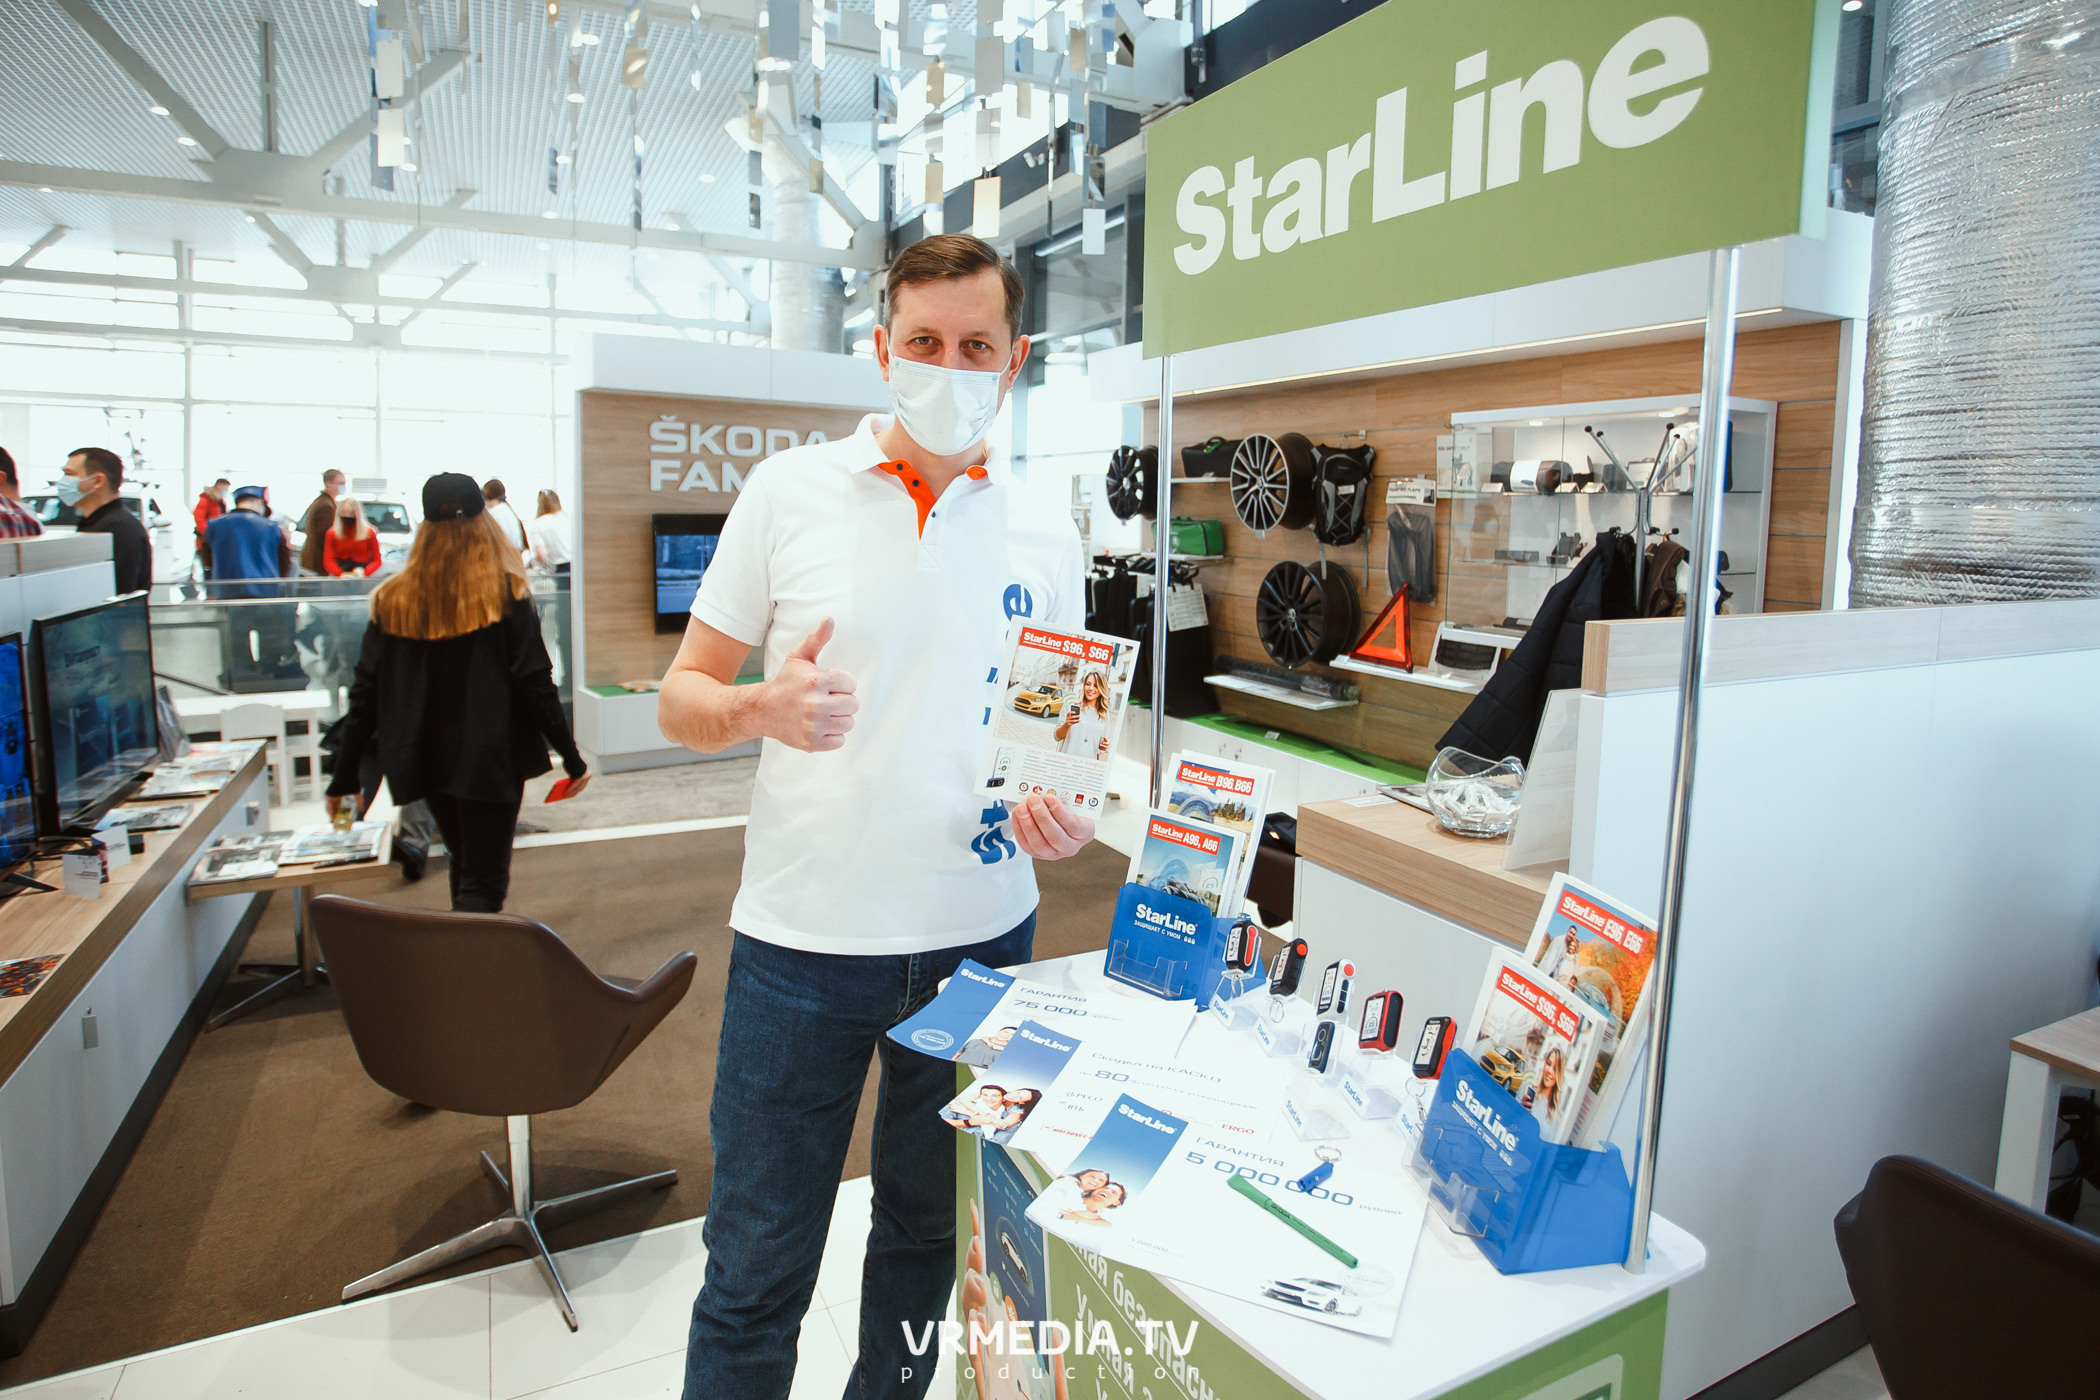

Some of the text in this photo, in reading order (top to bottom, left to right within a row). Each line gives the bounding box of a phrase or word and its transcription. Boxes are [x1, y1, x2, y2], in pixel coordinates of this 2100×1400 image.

[1173, 16, 1709, 275] StarLine
[1023, 631, 1110, 662] StarLine S96, S66
[1181, 767, 1252, 793] StarLine B96, B66
[1152, 823, 1219, 852] StarLine A96, A66
[1133, 919, 1161, 934] ЗАЩИЩАЕТ
[1166, 930, 1182, 941] УМОМ
[1136, 903, 1197, 936] StarLine
[1562, 896, 1644, 955] StarLine E96, E66
[961, 968, 1006, 988] StarLine
[1014, 999, 1088, 1017] 75 000
[1020, 987, 1087, 1003] ГАРАНТИЯ
[1501, 973, 1538, 1005] StarLine
[1536, 995, 1556, 1025] S96,
[1556, 1010, 1577, 1037] S66
[1213, 1000, 1229, 1020] StarLine
[1020, 1029, 1072, 1052] StarLine
[1256, 1024, 1271, 1046] StarLine
[1092, 1052, 1142, 1068] Скидка
[1167, 1065, 1222, 1083] КАСКО
[1094, 1070, 1130, 1083] 80
[1344, 1080, 1364, 1107] StarLine
[1118, 1103, 1176, 1135] StarLine
[1285, 1100, 1302, 1128] StarLine
[1456, 1079, 1517, 1152] StarLine
[1221, 1123, 1255, 1135] ERGO
[1196, 1137, 1285, 1168] ГАРАНТИЯ
[1185, 1151, 1207, 1165] 5
[1214, 1160, 1280, 1186] 000
